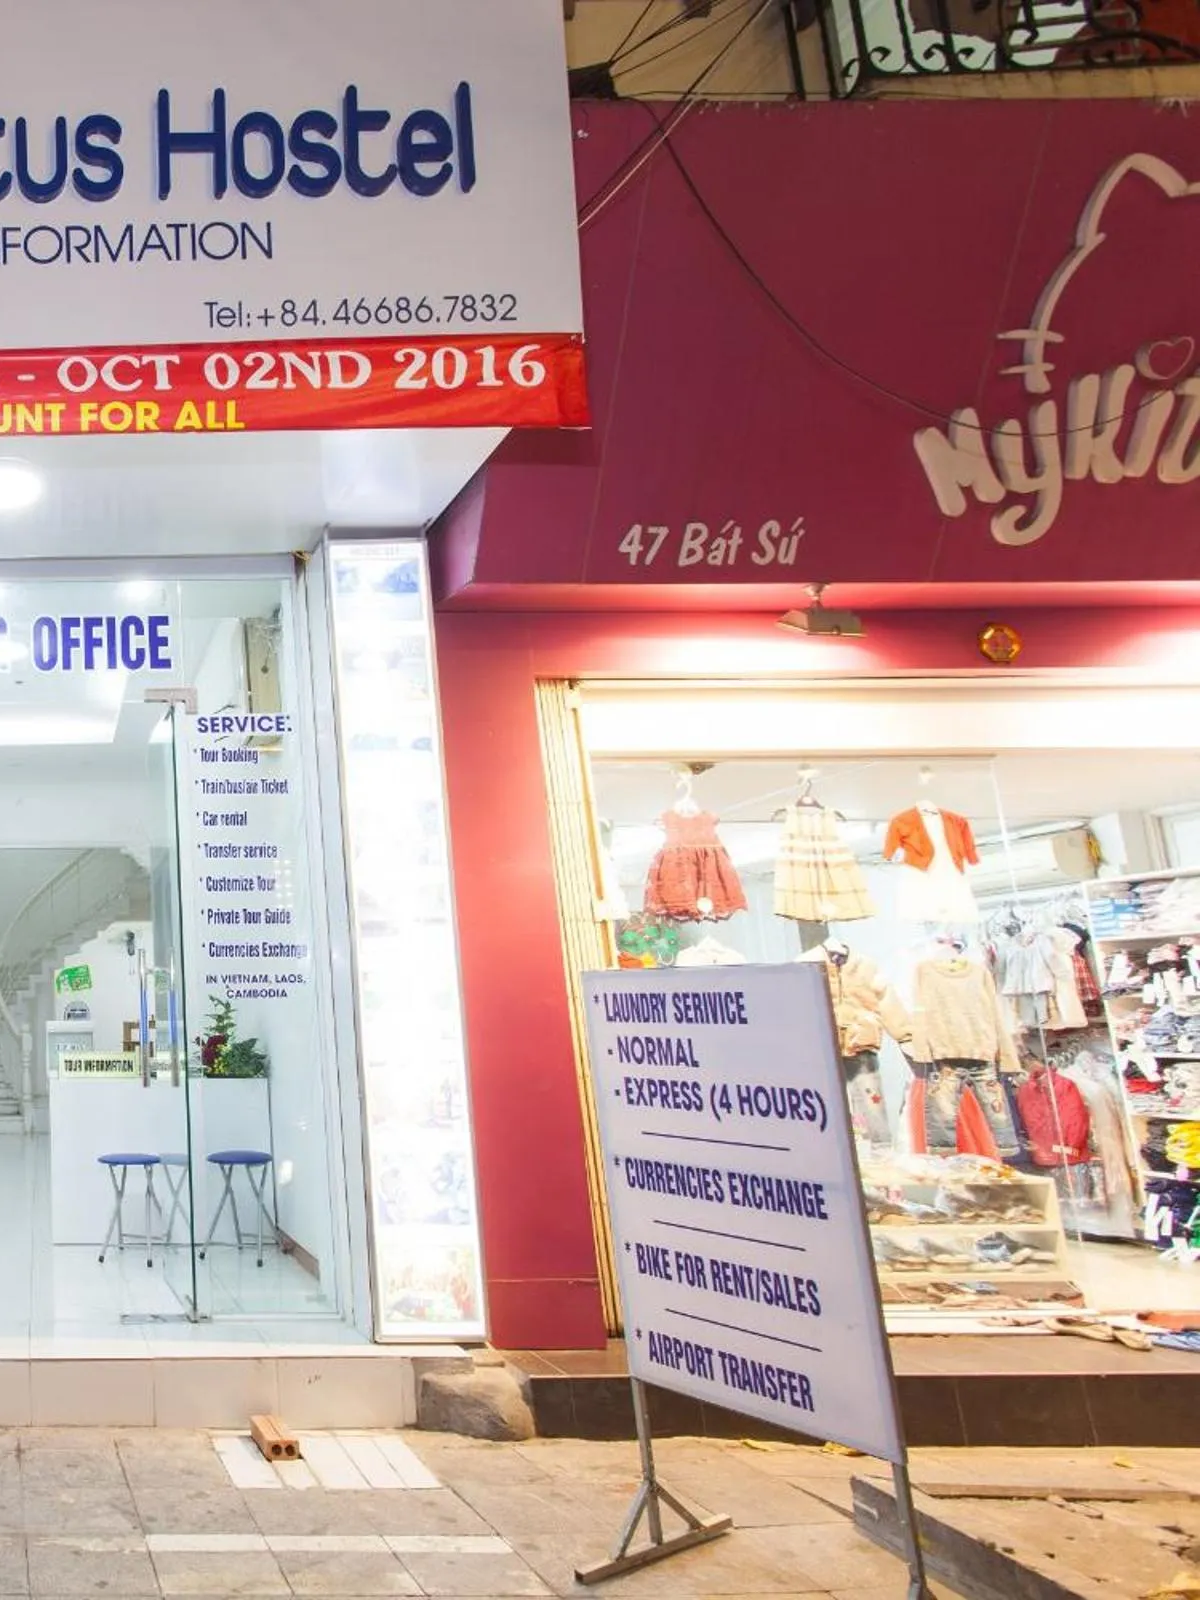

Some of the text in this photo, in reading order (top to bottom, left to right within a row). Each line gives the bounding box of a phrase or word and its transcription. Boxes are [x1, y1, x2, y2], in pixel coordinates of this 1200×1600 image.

[157, 80, 477, 200] Hostel
[57, 353, 180, 392] OCT
[203, 349, 373, 391] 02ND
[393, 343, 547, 390] 2016
[80, 399, 161, 432] FOR
[174, 397, 246, 431] ALL
[618, 523, 670, 566] 47
[677, 519, 744, 567] Bát
[33, 615, 172, 671] OFFICE
[197, 715, 293, 733] SERVICE:
[200, 748, 259, 764] Tour Booking
[260, 778, 290, 794] Ticket
[202, 811, 248, 826] Car rental
[204, 843, 278, 858] Transfer service
[206, 876, 276, 892] Customize Tour
[207, 909, 291, 925] Private Tour Guide
[208, 942, 260, 958] Currencies
[206, 974, 218, 985] IN
[226, 987, 288, 999] CAMBODIA
[603, 991, 748, 1025] LAUNDRY SERIVICE
[616, 1035, 700, 1068] NORMAL
[84, 1060, 134, 1072] INFORMATION
[623, 1076, 828, 1133] EXPRESS (4 HOURS)
[624, 1157, 828, 1220] CURRENCIES EXCHANGE
[634, 1242, 822, 1317] BIKE FOR RENT/SALES
[648, 1330, 815, 1413] AIRPORT TRANSFER
